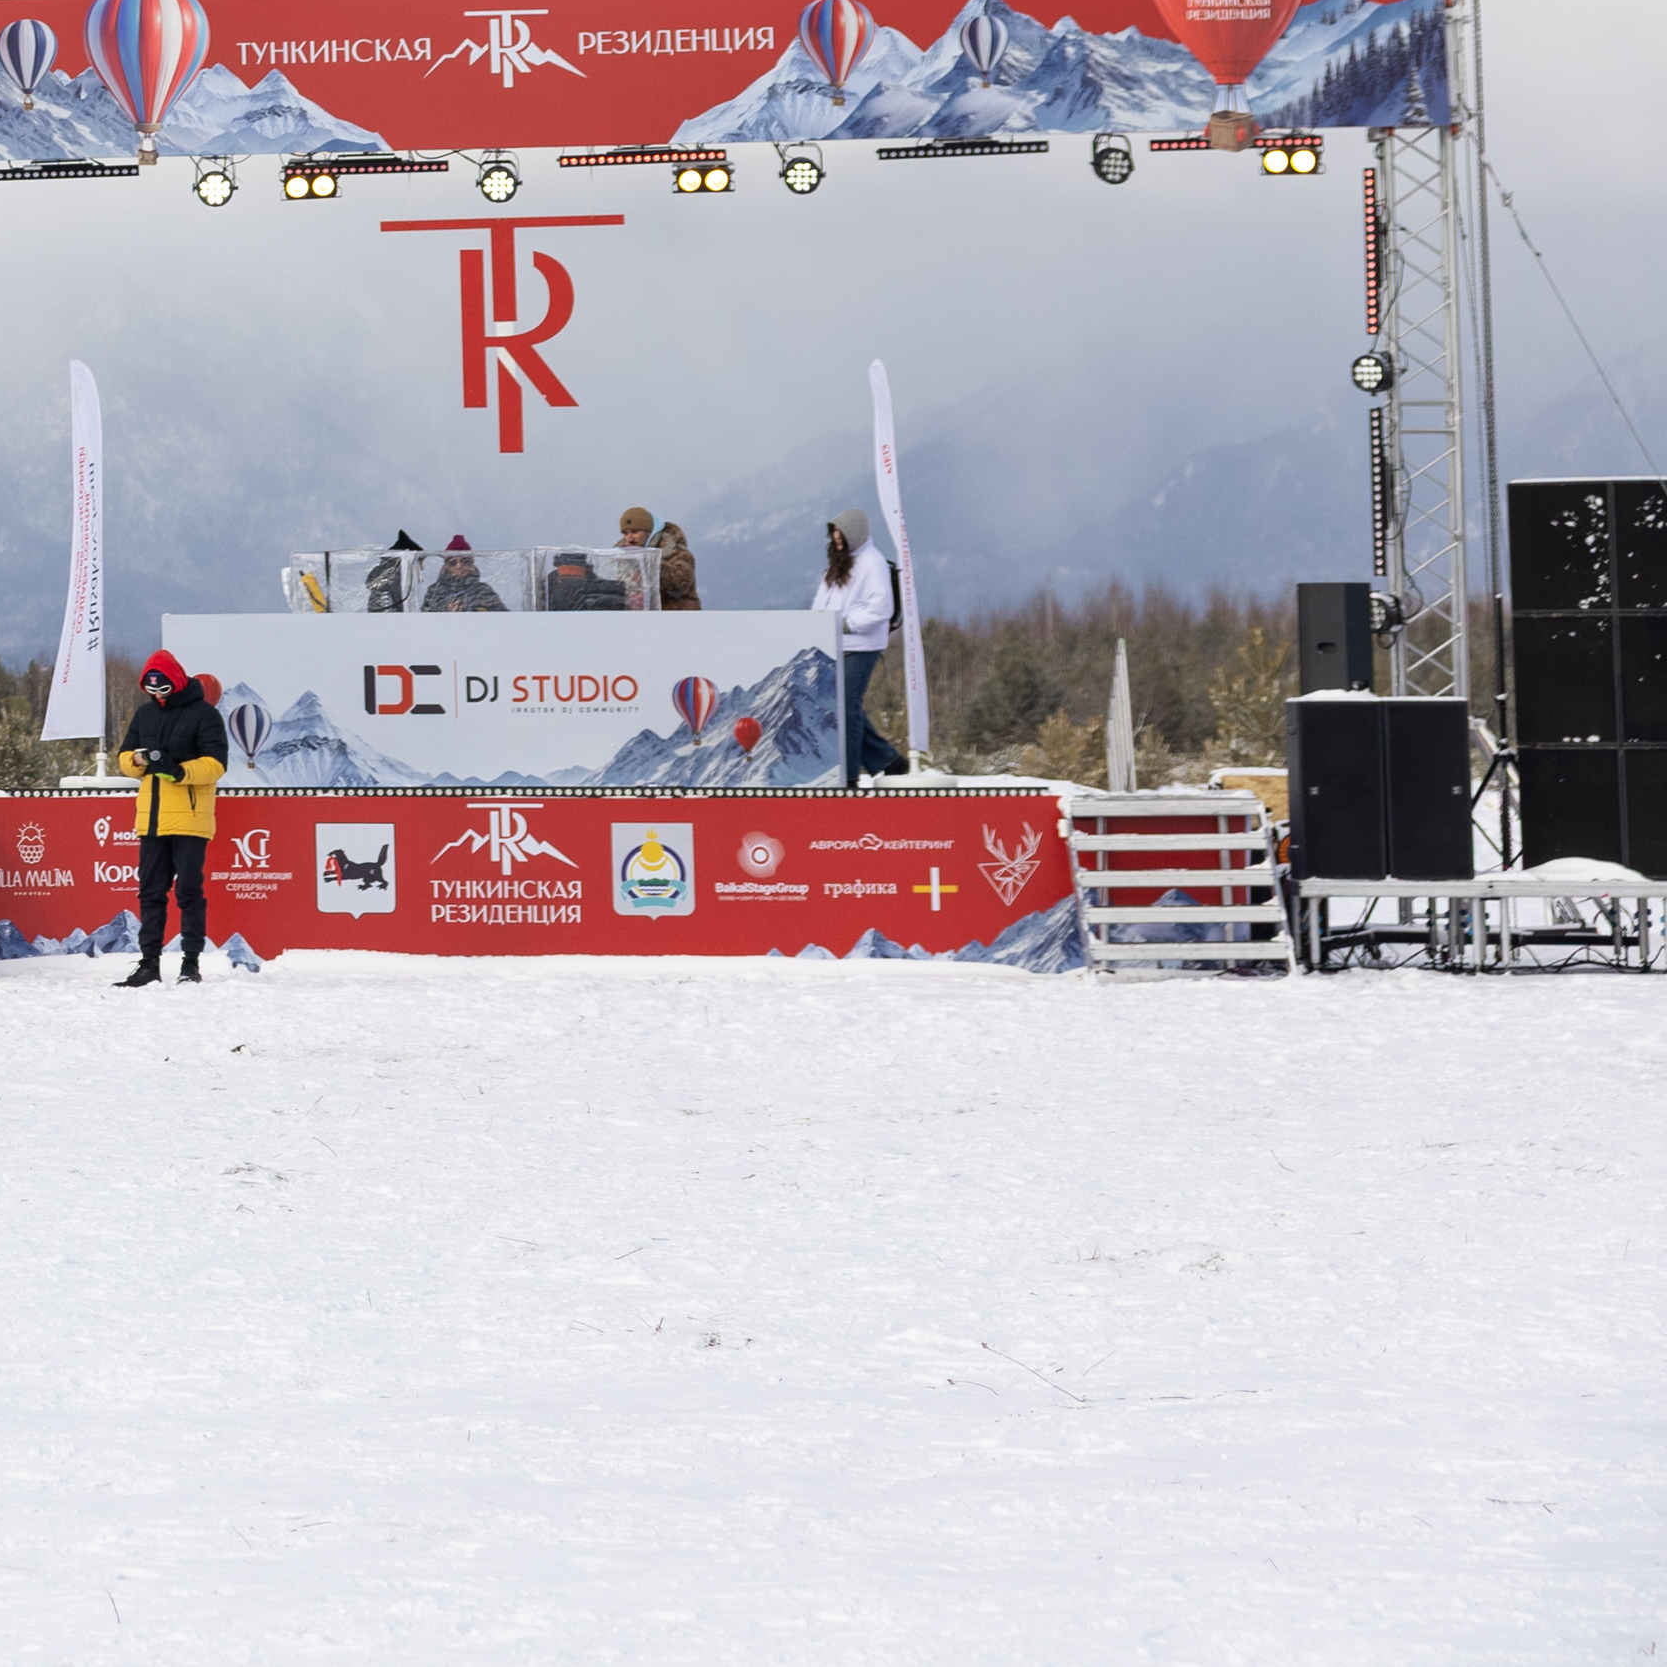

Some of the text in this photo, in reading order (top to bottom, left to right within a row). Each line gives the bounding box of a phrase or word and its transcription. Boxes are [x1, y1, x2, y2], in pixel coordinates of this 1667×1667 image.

[1185, 8, 1271, 20] РЕЗИДЕНЦИЯ
[236, 26, 775, 65] ТУНКИНСКАЯ РЕЗИДЕНЦИЯ
[466, 676, 499, 703] DJ
[512, 675, 639, 702] STUDIO
[809, 839, 956, 850] АВРОРА КЕЙТЕРИНГ
[226, 883, 278, 891] СЕРЕБРЯНАЯ
[429, 880, 582, 899] ТУНКИНСКАЯ
[714, 882, 809, 895] BaikalStageGroup
[823, 879, 898, 899] графика
[431, 904, 581, 926] РЕЗИДЕНЦИЯ
